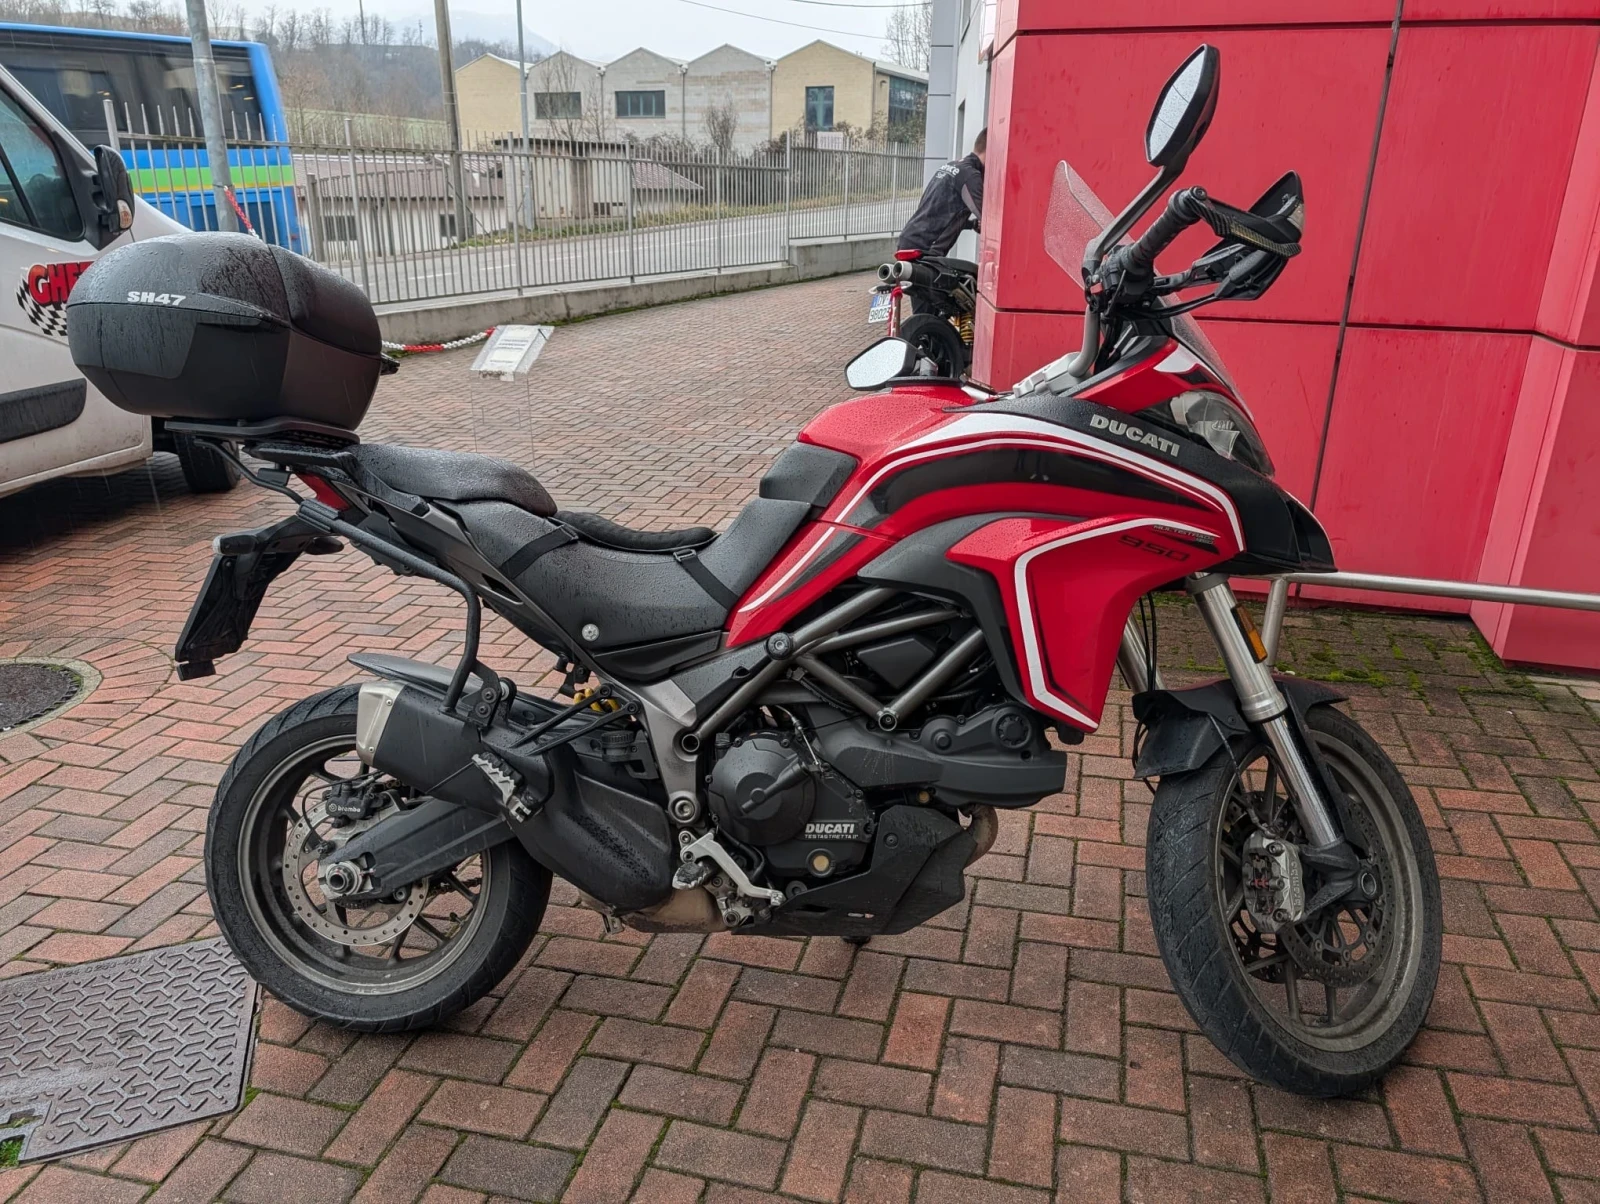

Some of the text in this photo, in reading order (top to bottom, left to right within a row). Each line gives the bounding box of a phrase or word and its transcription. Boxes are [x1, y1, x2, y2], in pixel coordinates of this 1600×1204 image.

[127, 291, 186, 306] SH47
[1090, 414, 1180, 457] DUCATI
[1118, 534, 1190, 562] 950
[337, 804, 361, 813] brembo
[805, 823, 855, 834] DUCATI
